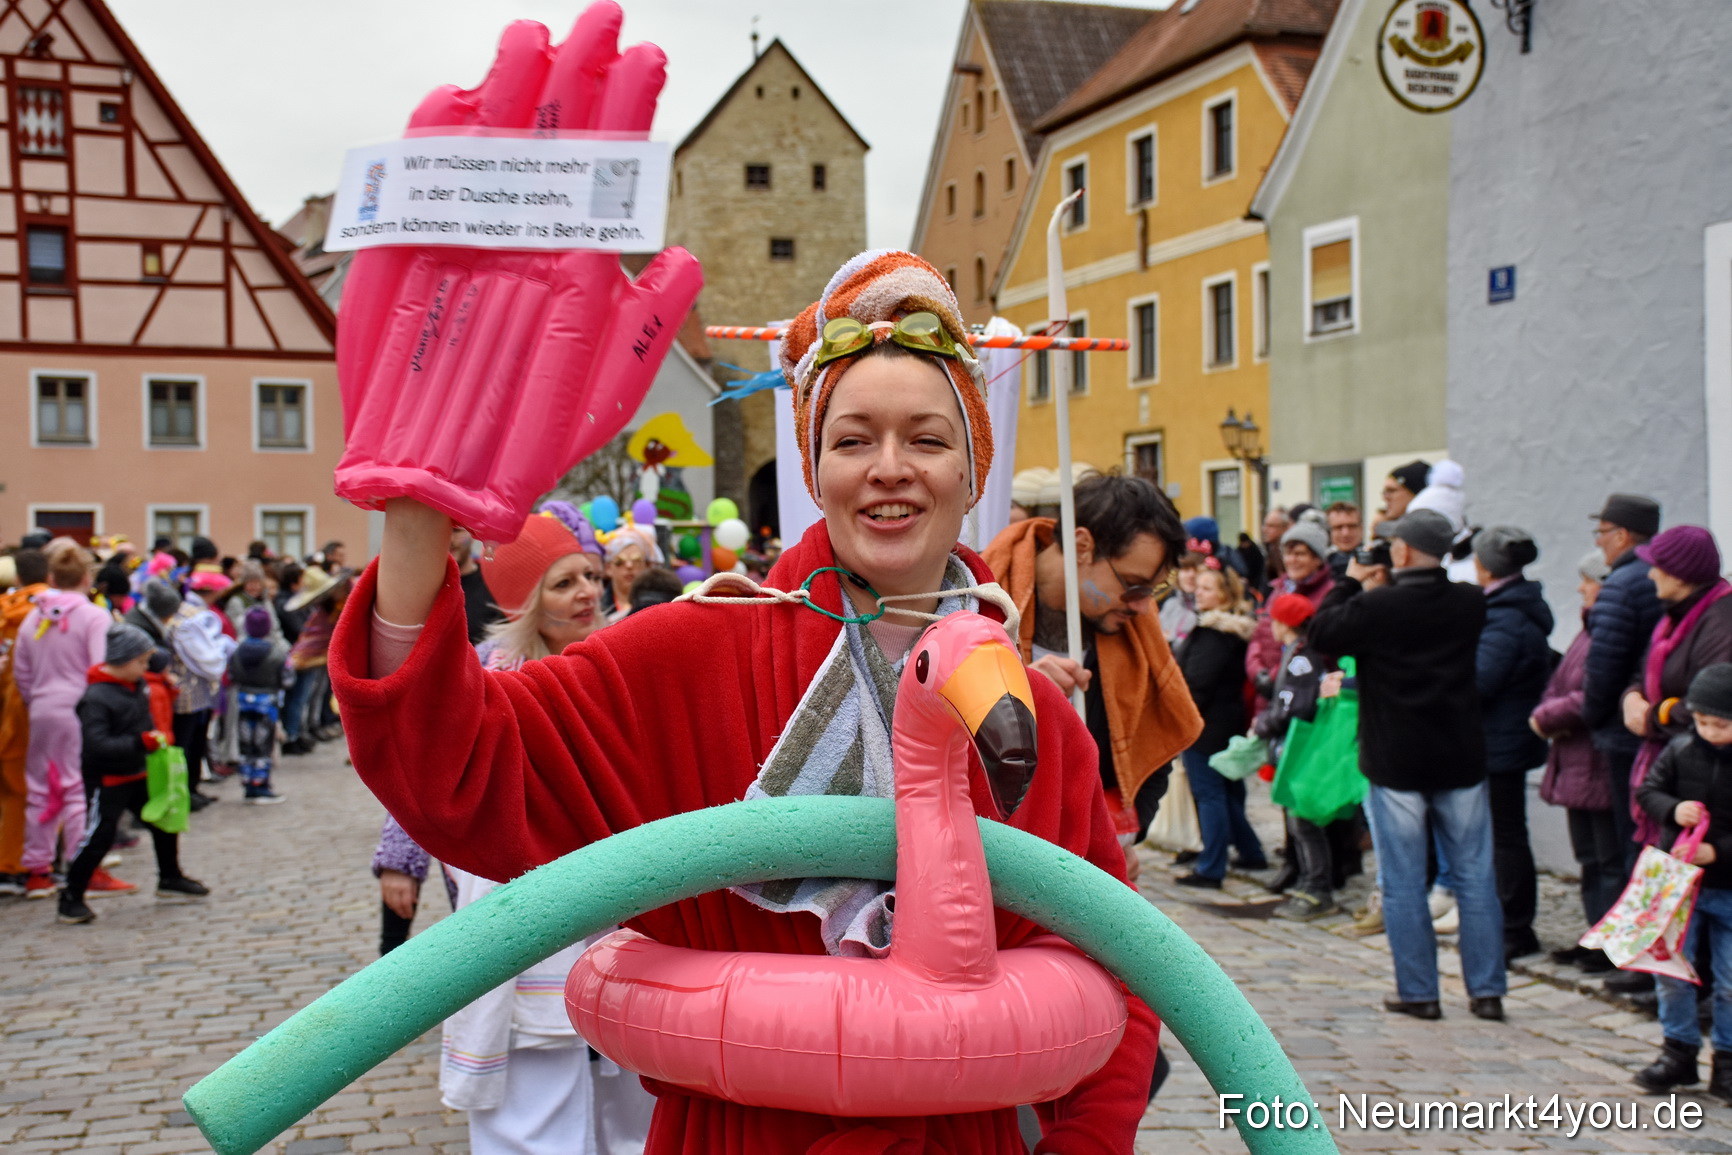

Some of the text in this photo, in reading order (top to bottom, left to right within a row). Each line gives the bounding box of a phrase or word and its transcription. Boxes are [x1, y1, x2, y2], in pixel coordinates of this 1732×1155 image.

[403, 155, 590, 174] Wir müssen nicht mehr
[408, 185, 574, 208] in der Dusche stehn,
[340, 217, 645, 243] sondern können wieder ins Berle gehn.
